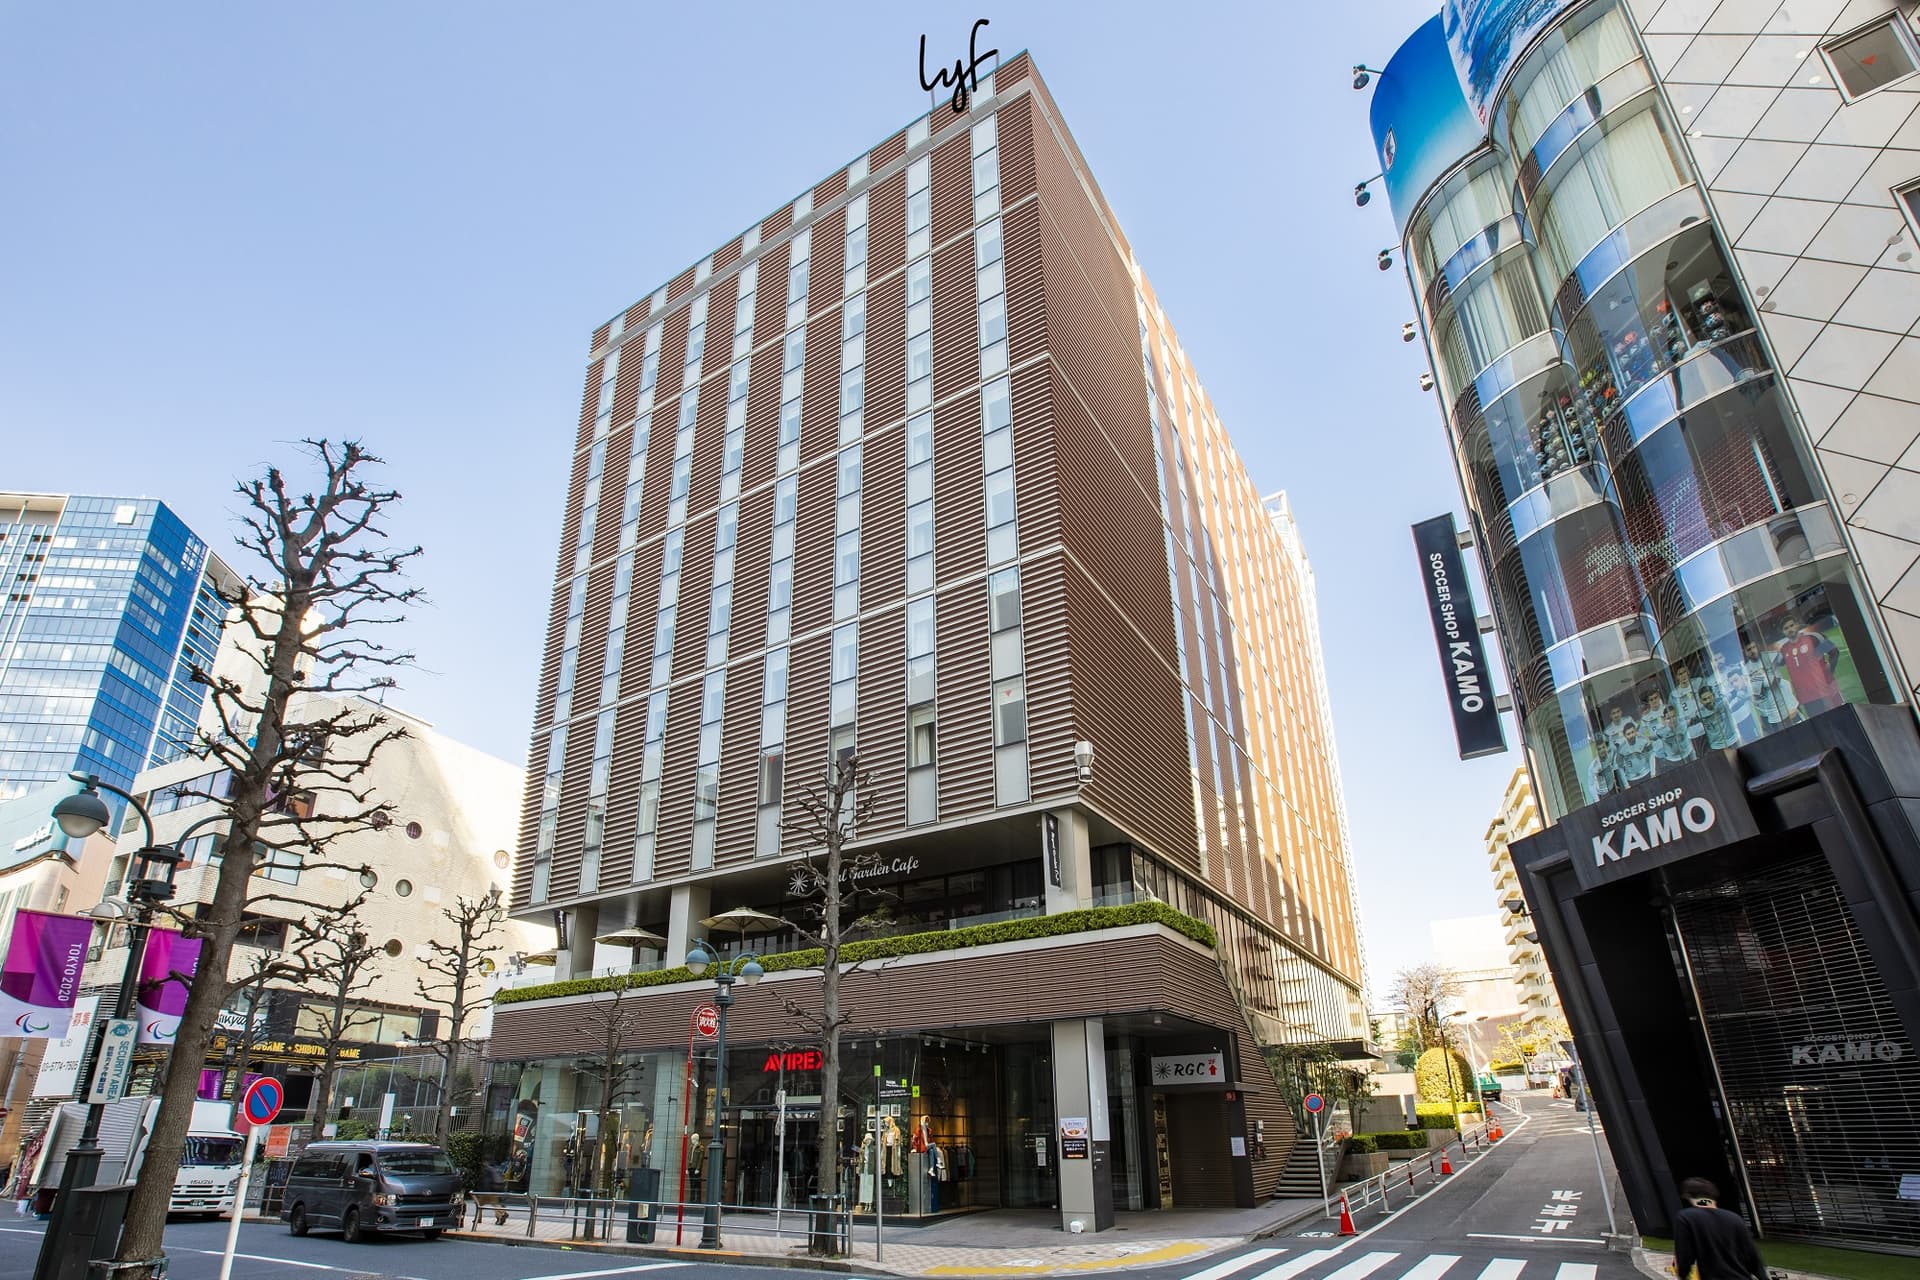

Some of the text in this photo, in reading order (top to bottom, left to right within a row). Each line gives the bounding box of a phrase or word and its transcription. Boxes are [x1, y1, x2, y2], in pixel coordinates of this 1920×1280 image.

[919, 18, 998, 113] lyf
[1429, 552, 1484, 713] SOCCER SHOP KAMO
[1592, 797, 1716, 867] KAMO
[1601, 787, 1683, 828] SOCCER SHOP
[892, 856, 920, 875] Cafe
[58, 943, 83, 1002] TOKYO 2020
[106, 1040, 130, 1101] SECURITY AREA
[1174, 1062, 1206, 1077] RGC
[1791, 1041, 1902, 1065] KAMO
